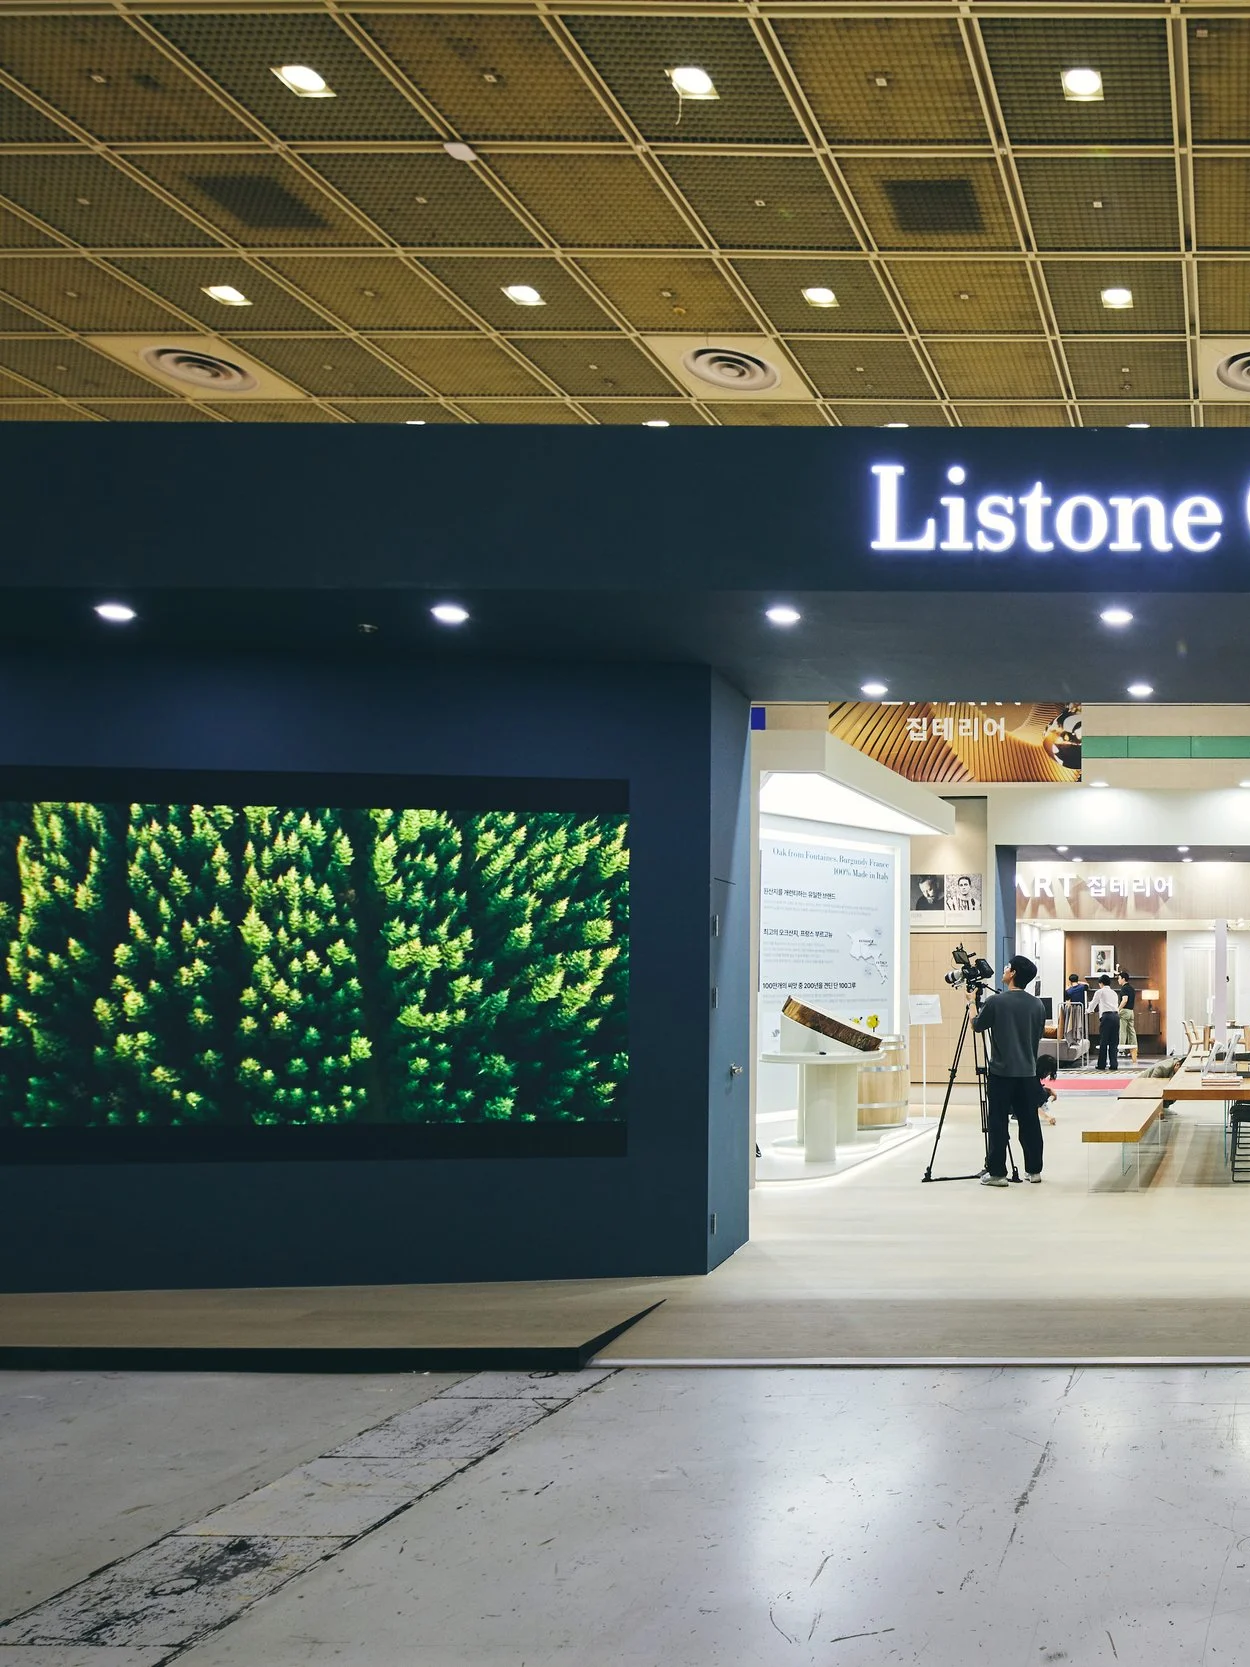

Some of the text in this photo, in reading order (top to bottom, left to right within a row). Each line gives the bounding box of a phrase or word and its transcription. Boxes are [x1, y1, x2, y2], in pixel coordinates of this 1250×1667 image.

[870, 465, 1222, 552] Listone
[905, 717, 1006, 742] 집테리어
[772, 847, 787, 857] Oak
[787, 848, 805, 859] from
[839, 854, 868, 867] Burgundy
[869, 858, 890, 868] France
[833, 867, 889, 883] 100% Made in Italy
[1086, 875, 1174, 898] 집테리어
[763, 928, 779, 936] 최고의
[800, 929, 814, 938] 프랑스
[803, 982, 823, 990] 200년을
[839, 982, 856, 990] 100그루
